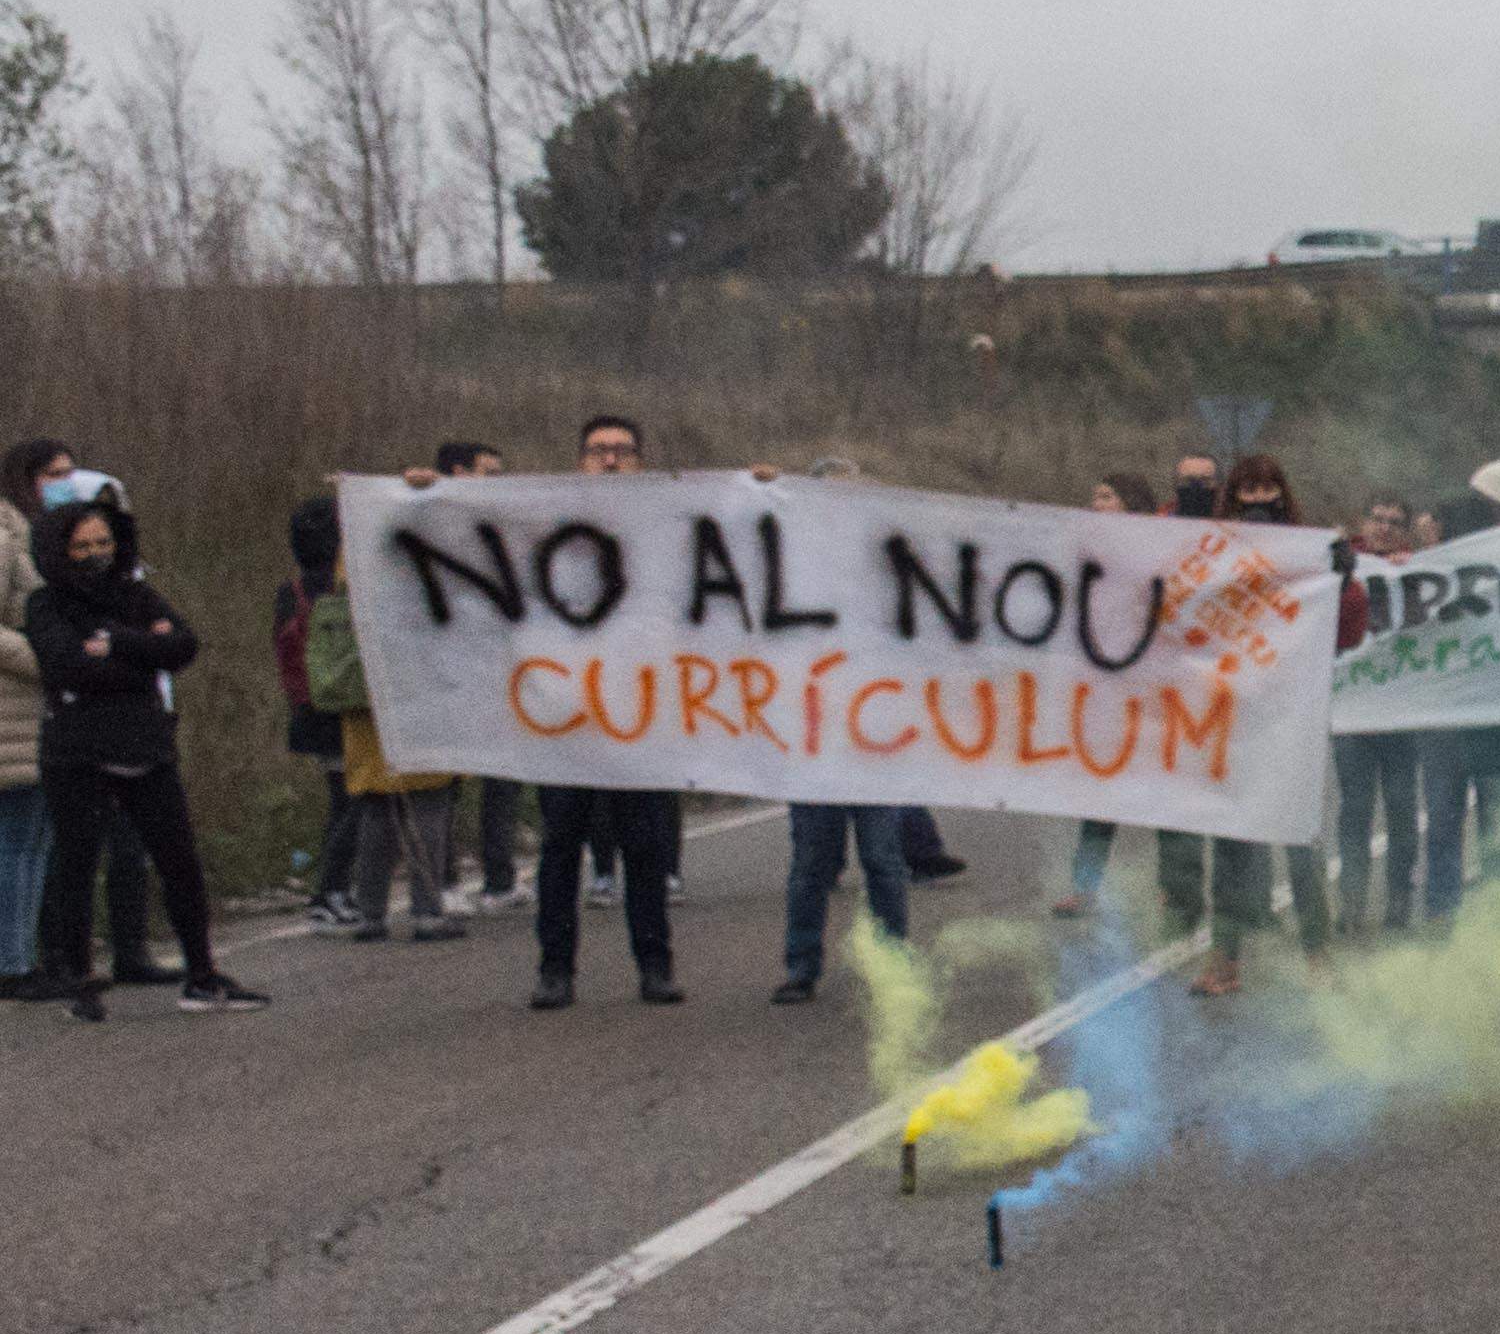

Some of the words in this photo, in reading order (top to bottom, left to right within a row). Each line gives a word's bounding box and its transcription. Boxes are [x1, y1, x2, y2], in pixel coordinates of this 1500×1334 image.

[395, 517, 626, 628] NO
[688, 512, 838, 633] AL
[886, 531, 1166, 670] NOU
[506, 650, 1239, 782] CURRÍCULUM
